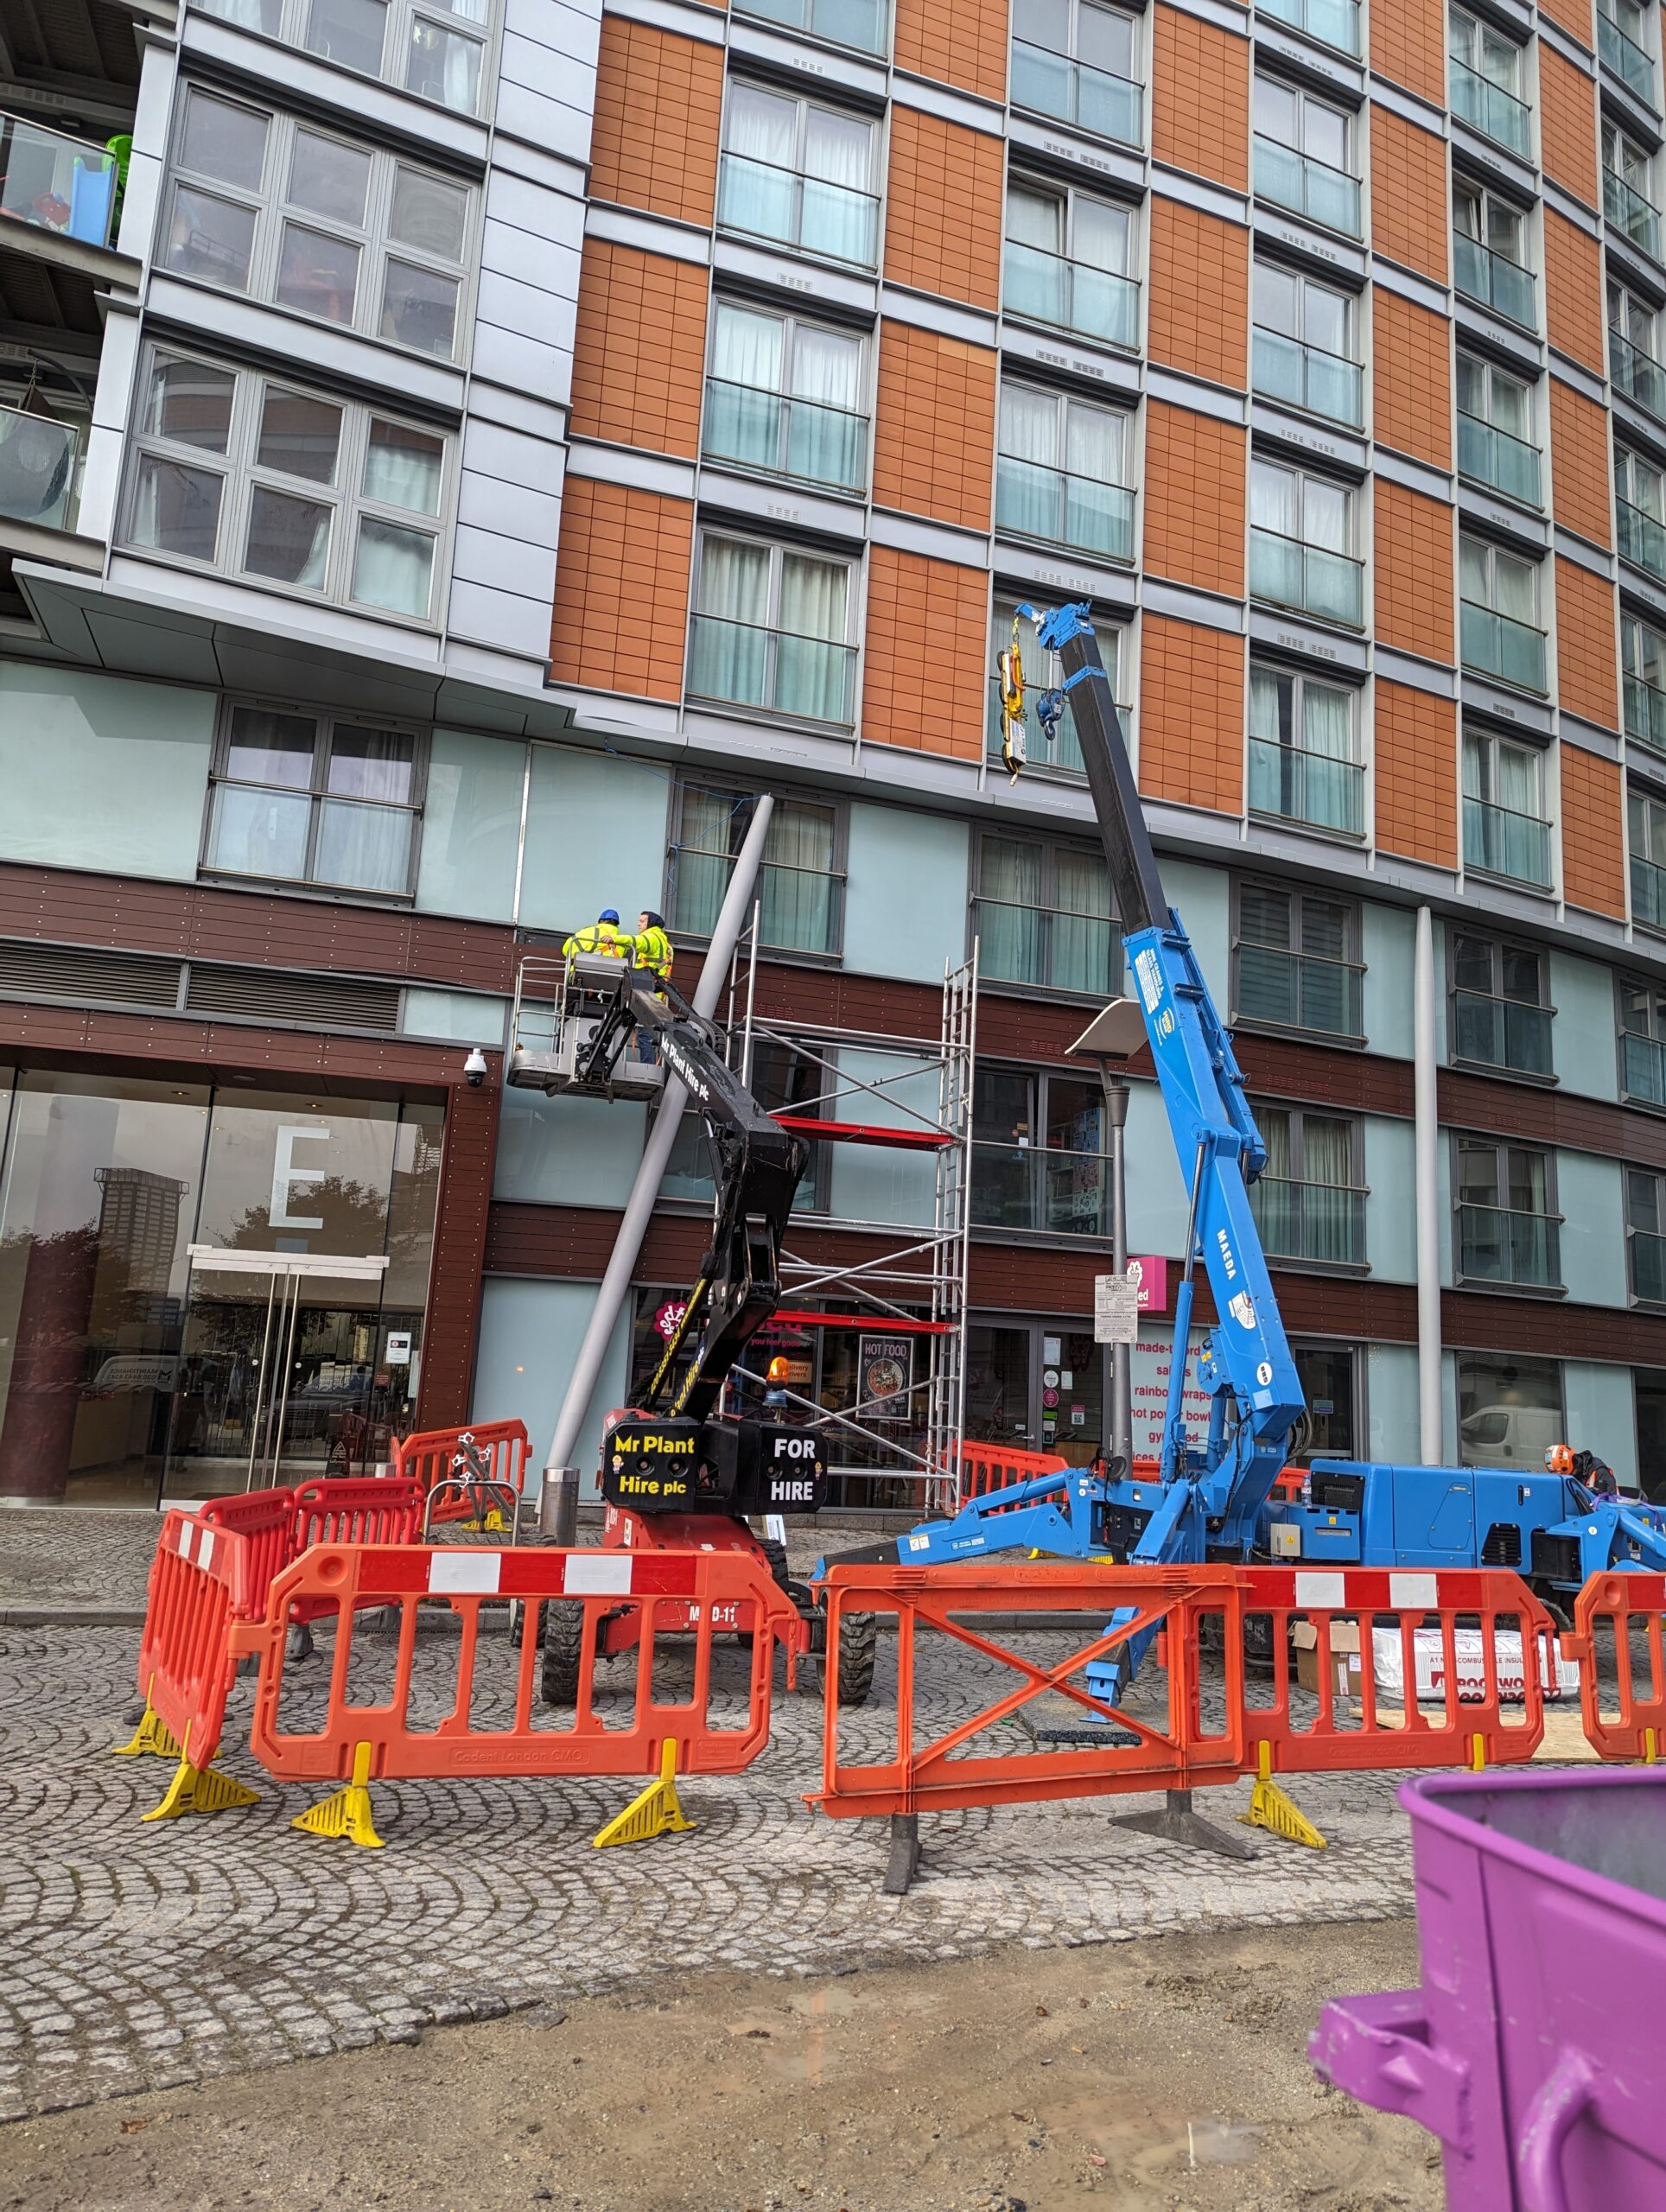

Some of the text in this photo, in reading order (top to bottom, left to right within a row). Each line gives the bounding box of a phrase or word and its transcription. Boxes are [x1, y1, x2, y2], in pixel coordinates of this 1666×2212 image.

[661, 1033, 709, 1102] Mr Plant Hire plc
[268, 1125, 330, 1230] E
[1217, 1228, 1237, 1281] MAEDA
[865, 1343, 907, 1357] HOT FOOD
[1135, 1386, 1212, 1402] rainbo wraps
[1186, 1410, 1211, 1421] bowl
[614, 1431, 695, 1454] Mr Plant
[774, 1438, 816, 1459] FOR
[619, 1476, 687, 1496] Hire plc
[771, 1480, 813, 1501] HIRE
[455, 1749, 583, 1764] Cadent London CMO
